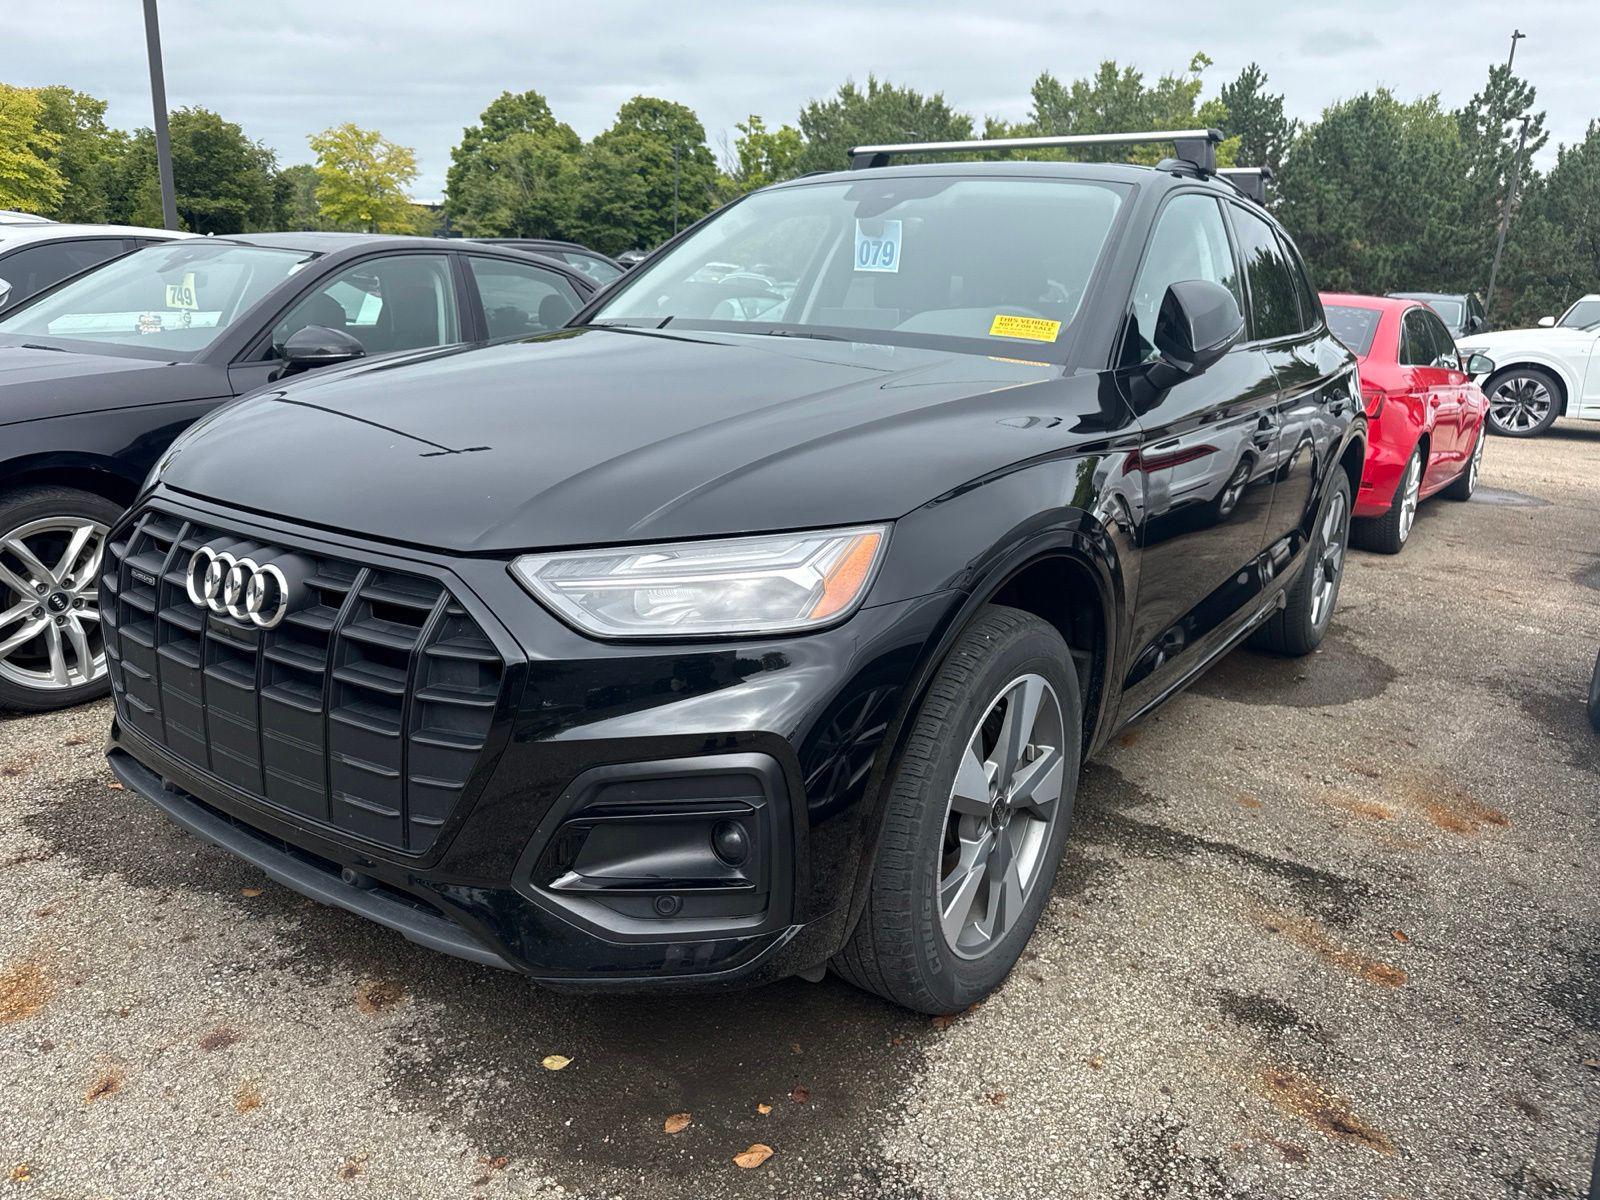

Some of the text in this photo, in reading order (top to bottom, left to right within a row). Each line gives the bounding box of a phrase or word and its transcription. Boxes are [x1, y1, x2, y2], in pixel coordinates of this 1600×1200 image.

[860, 240, 894, 266] 079
[170, 286, 192, 306] 749
[1020, 318, 1056, 328] VEHICLE
